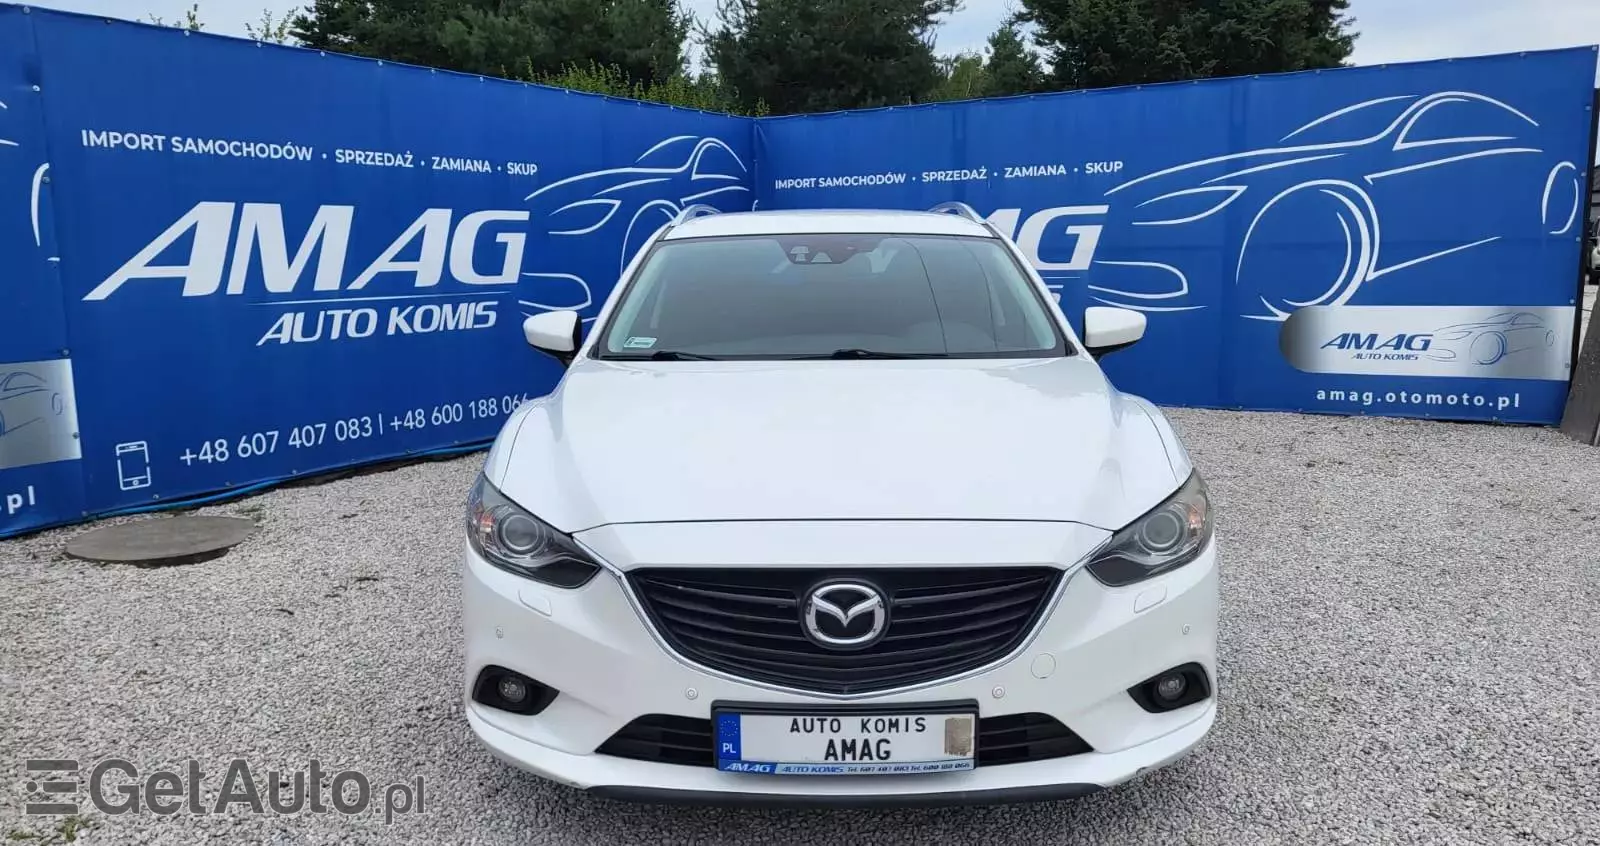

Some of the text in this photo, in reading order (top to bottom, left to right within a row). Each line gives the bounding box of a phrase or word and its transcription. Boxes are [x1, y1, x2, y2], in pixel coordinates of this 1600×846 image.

[81, 129, 538, 176] IMPORT SAMOCHODÓW SPRZEDAŻ ZAMIANA SKUP
[775, 161, 1124, 190] IMPORT SAMOCHODÓW SPRZEDAŻ ZAMIANA SKUP
[82, 201, 530, 300] AMAG
[256, 301, 499, 346] AUTO KOMIS
[1320, 333, 1434, 351] AMAG
[1351, 353, 1419, 361] AUTO KOMIS
[1316, 389, 1520, 409] amag.otomoto.pl
[180, 438, 229, 466] +48
[237, 431, 280, 458] 607
[288, 423, 327, 449] 407
[334, 416, 373, 442] 083
[389, 408, 426, 431] +48
[431, 402, 463, 426] 600
[469, 398, 498, 419] 188
[790, 717, 927, 733] AUTO KOMIS
[722, 742, 737, 753] PL
[824, 738, 892, 761] AMAG
[725, 762, 772, 773] AMAG
